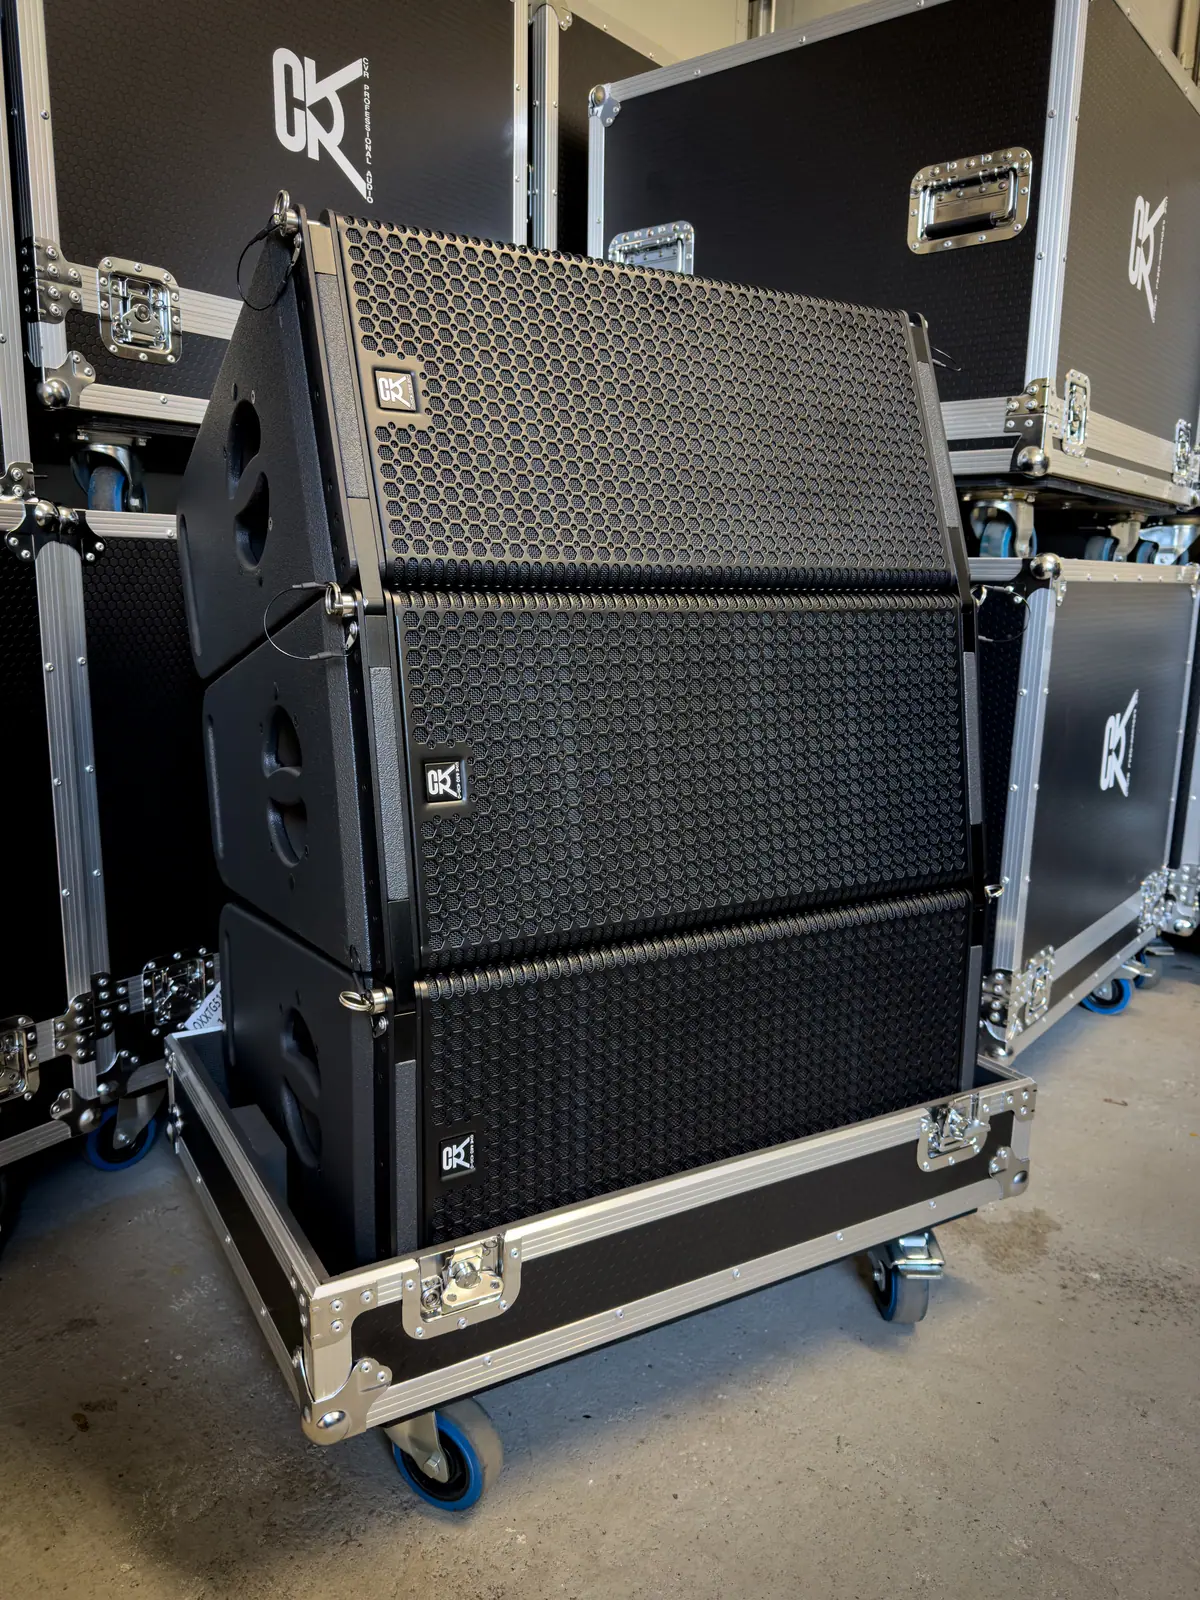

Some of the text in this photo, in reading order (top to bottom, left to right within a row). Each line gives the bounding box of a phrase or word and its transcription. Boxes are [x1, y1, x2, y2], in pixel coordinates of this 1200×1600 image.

[362, 57, 374, 204] CVR PROFESSIONAL AUDIO
